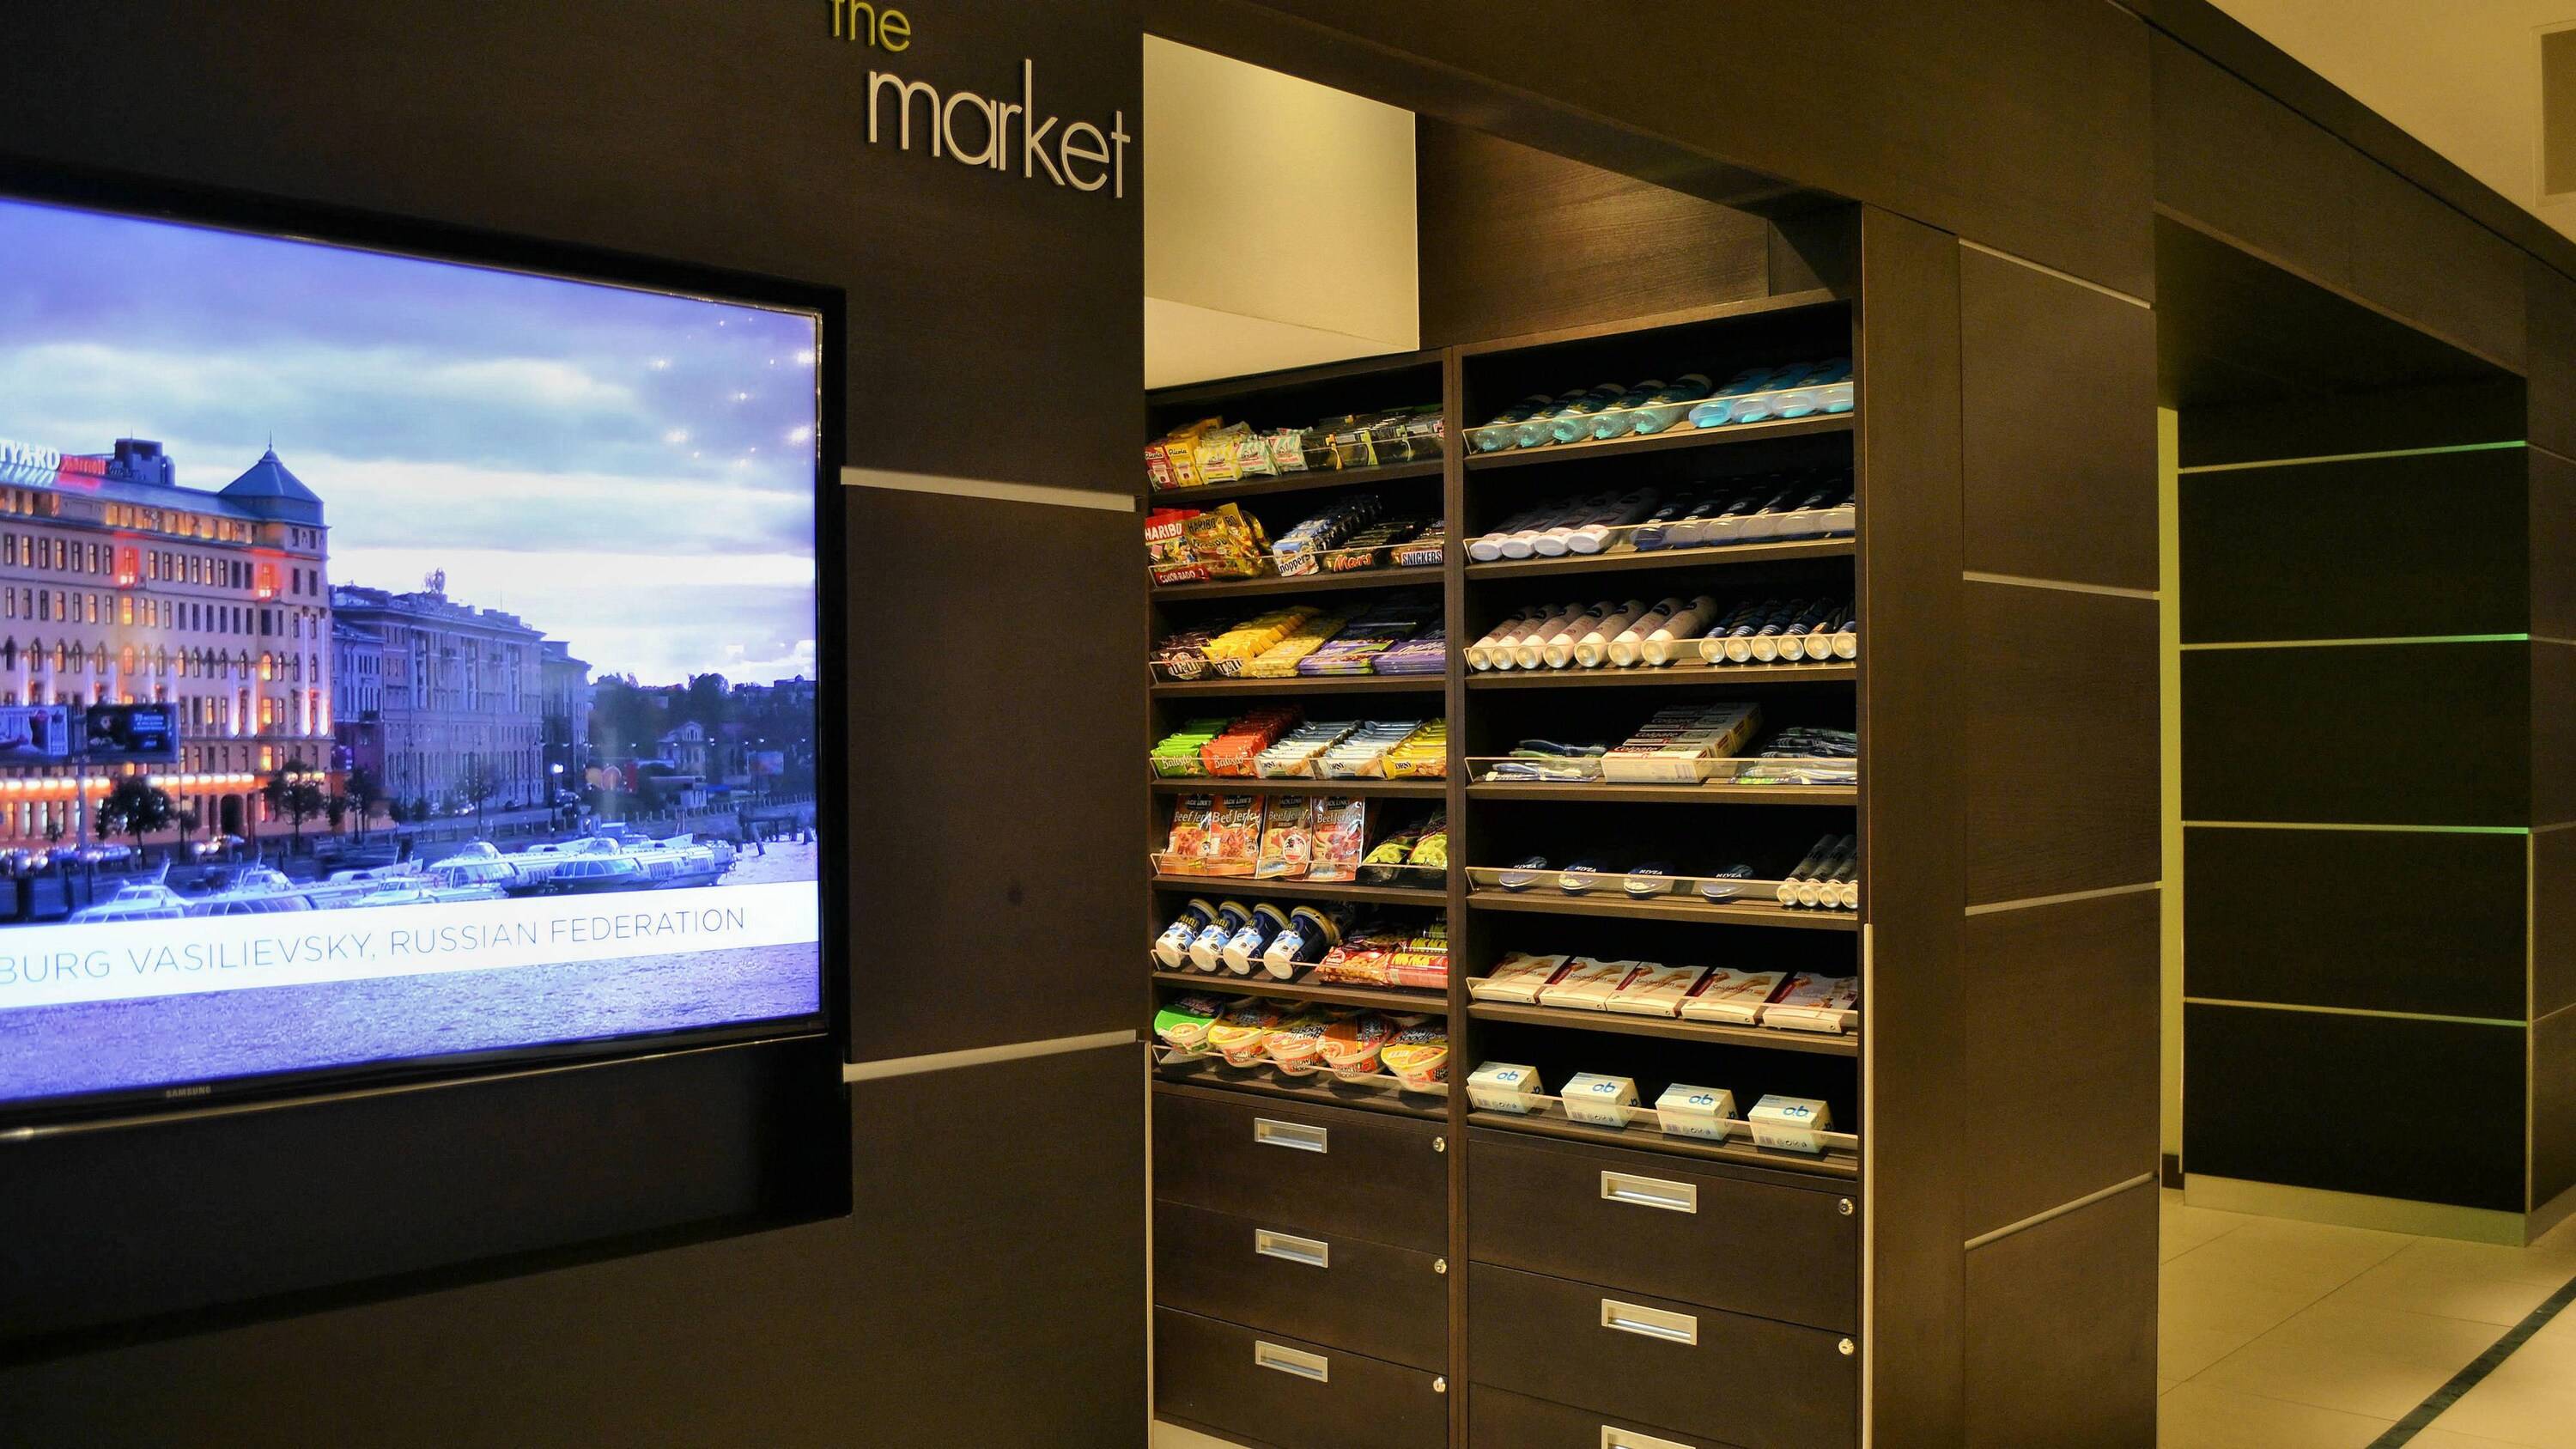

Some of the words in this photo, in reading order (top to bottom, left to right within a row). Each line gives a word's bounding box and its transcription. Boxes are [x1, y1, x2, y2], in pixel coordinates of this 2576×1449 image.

[829, 0, 911, 52] the
[867, 58, 1132, 199] market
[1334, 552, 1372, 572] Mars
[1401, 551, 1443, 566] SNICKERS
[1574, 865, 1596, 874] NIVEA
[0, 950, 111, 984] BURG
[127, 932, 378, 975] VASILIEVSKY,
[391, 921, 538, 956] RUSSIAN
[550, 906, 745, 944] FEDERATION
[165, 1085, 212, 1099] SAMSUNG
